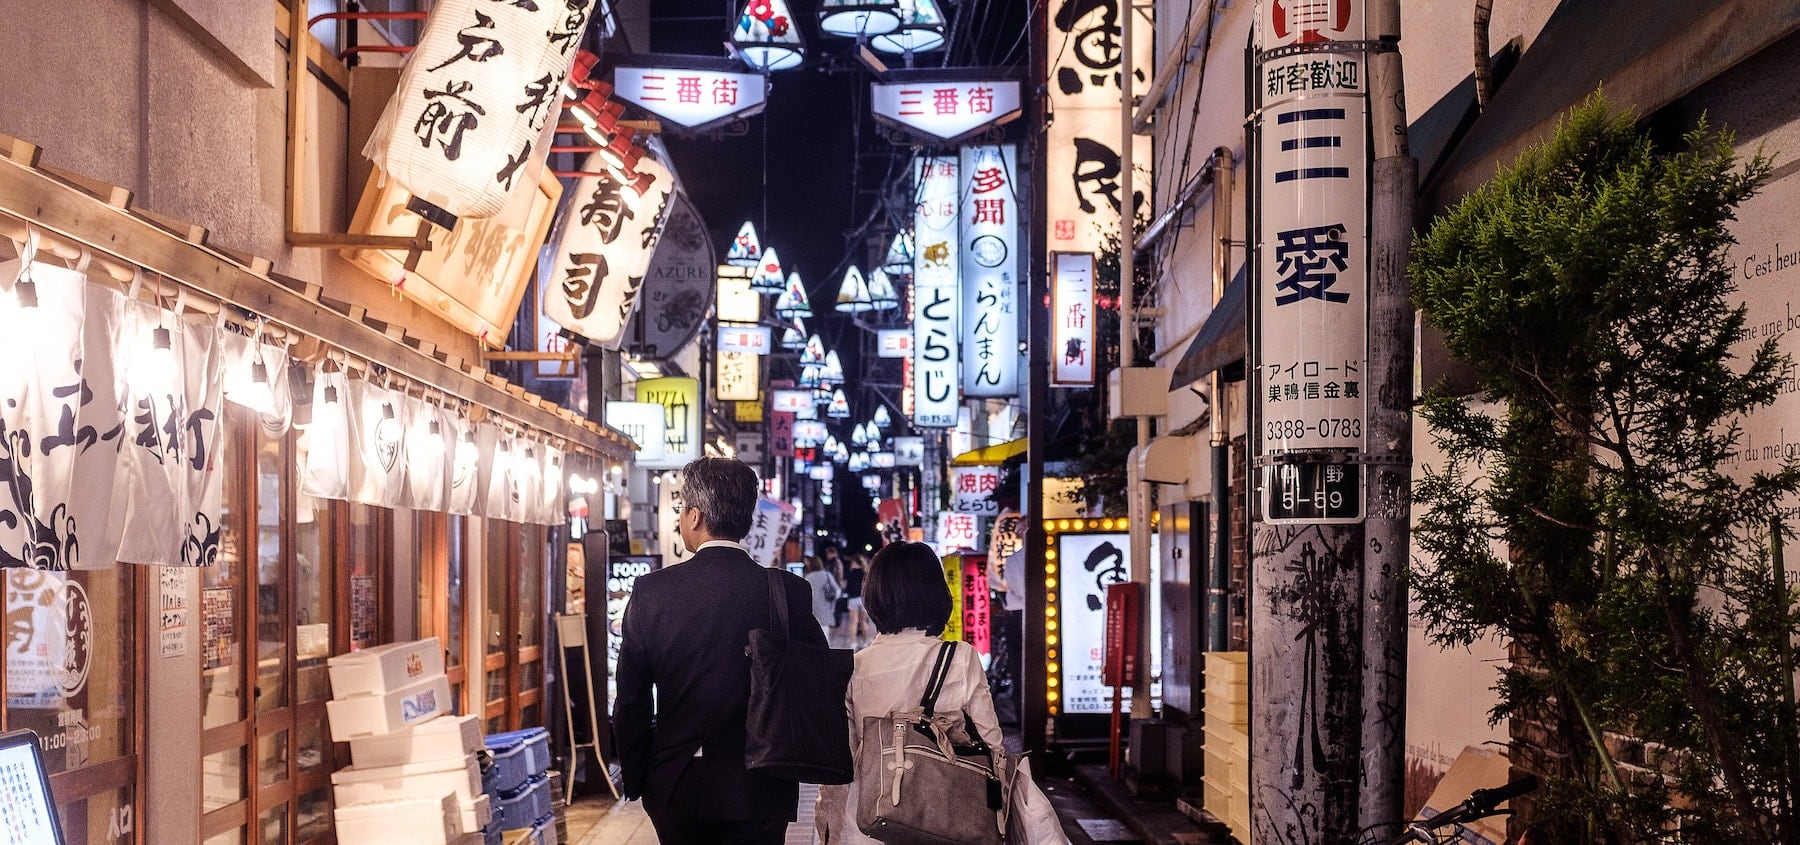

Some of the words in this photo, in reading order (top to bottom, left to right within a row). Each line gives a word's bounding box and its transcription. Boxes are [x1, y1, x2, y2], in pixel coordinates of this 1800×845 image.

[414, 0, 540, 160] 戸前
[640, 74, 739, 106] 三番街
[1267, 59, 1359, 97] 新客歓迎
[898, 87, 994, 117] 三番街
[1274, 107, 1351, 306] 三愛
[561, 172, 636, 320] 寿司
[655, 265, 708, 279] AZURE
[1743, 254, 1772, 280] C'est
[1776, 243, 1800, 271] heu
[973, 282, 1002, 387] らんまん
[1761, 319, 1783, 337] une
[922, 287, 951, 403] とらじ
[1268, 359, 1359, 381] アイロード
[647, 390, 687, 408] PIZZA
[1268, 381, 1360, 403] 巣鴨信金裏
[920, 415, 952, 425] 中野店
[1266, 418, 1362, 441] 3388-0783
[1744, 433, 1759, 463] du
[958, 473, 998, 494] 焼肉
[1282, 491, 1343, 510] 5-59
[612, 562, 651, 578] FOOD
[106, 804, 133, 842] 入口
